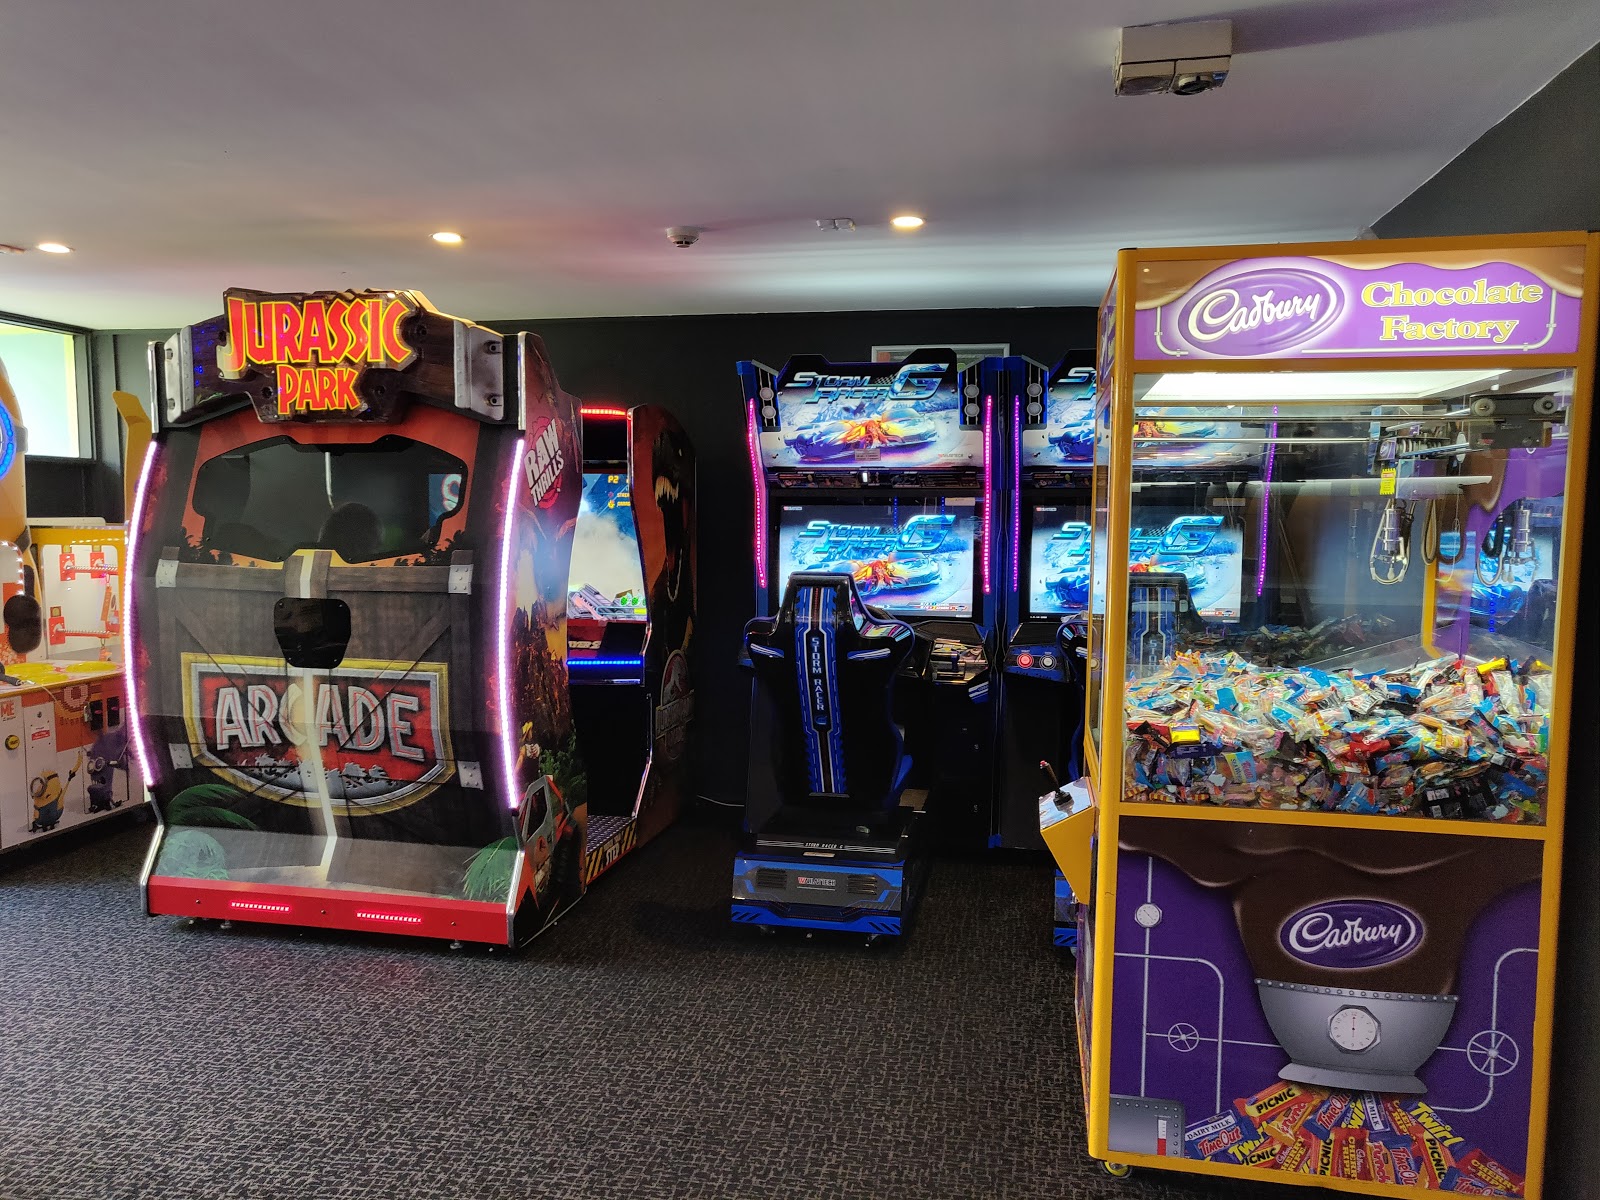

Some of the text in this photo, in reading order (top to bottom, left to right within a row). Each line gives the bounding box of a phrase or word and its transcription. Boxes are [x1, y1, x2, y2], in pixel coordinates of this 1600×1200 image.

[1361, 278, 1543, 307] Chocolate
[223, 297, 412, 372] JURASSIC
[1188, 288, 1320, 341] Cadbury
[1379, 314, 1519, 343] Factory
[276, 364, 361, 415] PARK
[524, 418, 559, 489] RAW
[531, 449, 564, 507] THRILLS
[607, 475, 619, 484] P2
[811, 637, 822, 674] STORM
[814, 678, 825, 711] RACER
[215, 683, 425, 762] ARCADE
[1289, 912, 1402, 953] Cadbury
[1255, 1087, 1296, 1114] PICNIC
[1186, 1119, 1232, 1141] DAIRY MILK
[1410, 1101, 1465, 1148] Twirl
[1426, 1137, 1446, 1180] PICNIC
[1471, 1159, 1520, 1193] CHERRY
